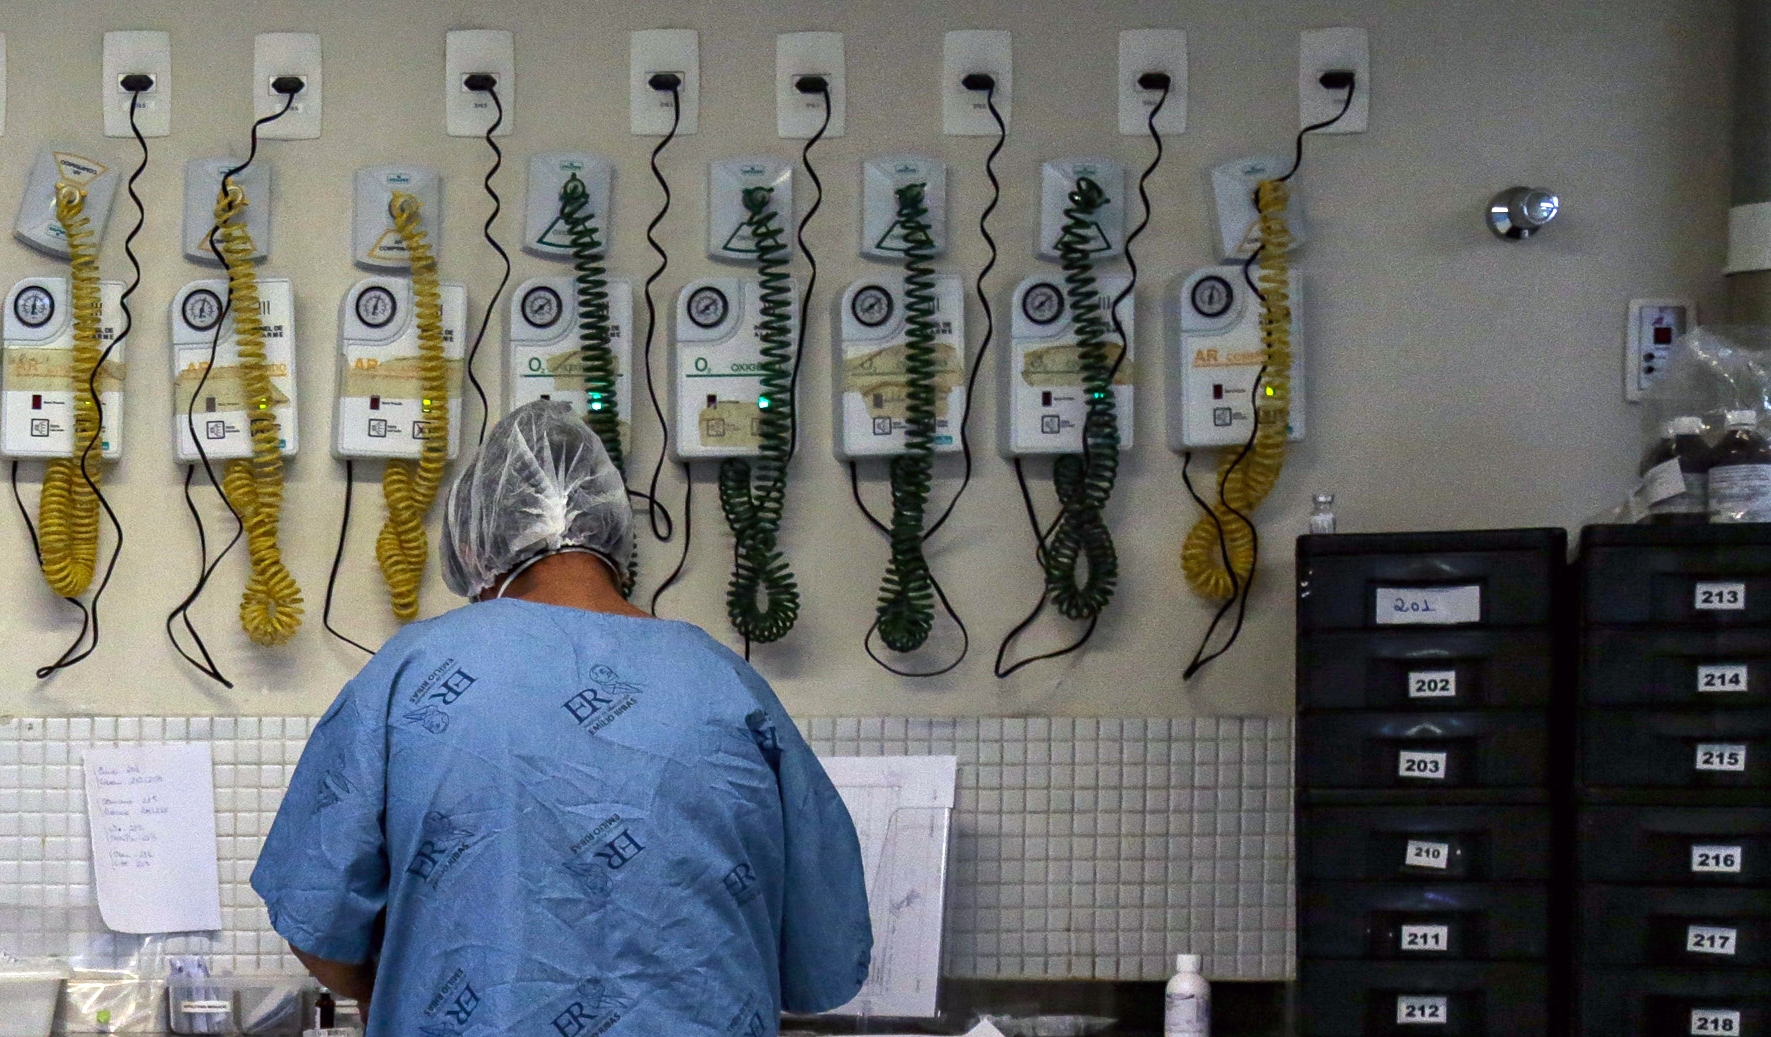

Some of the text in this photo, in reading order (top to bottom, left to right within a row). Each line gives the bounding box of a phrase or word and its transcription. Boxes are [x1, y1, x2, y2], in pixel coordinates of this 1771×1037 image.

[1701, 590, 1739, 604] 213
[1393, 598, 1437, 613] 201
[428, 667, 478, 706] ER
[1415, 678, 1450, 693] 202
[1703, 672, 1741, 687] 214
[561, 688, 613, 725] ER
[1405, 759, 1440, 774] 203
[1701, 752, 1740, 766] 215
[593, 828, 646, 870] ER
[1414, 846, 1441, 860] 210
[1697, 852, 1735, 867] 216
[719, 862, 757, 898] ER
[1407, 933, 1441, 946] 211
[1692, 934, 1730, 949] 217
[444, 982, 480, 1026] ER
[1404, 1004, 1440, 1018] 212
[1696, 1017, 1734, 1032] 218
